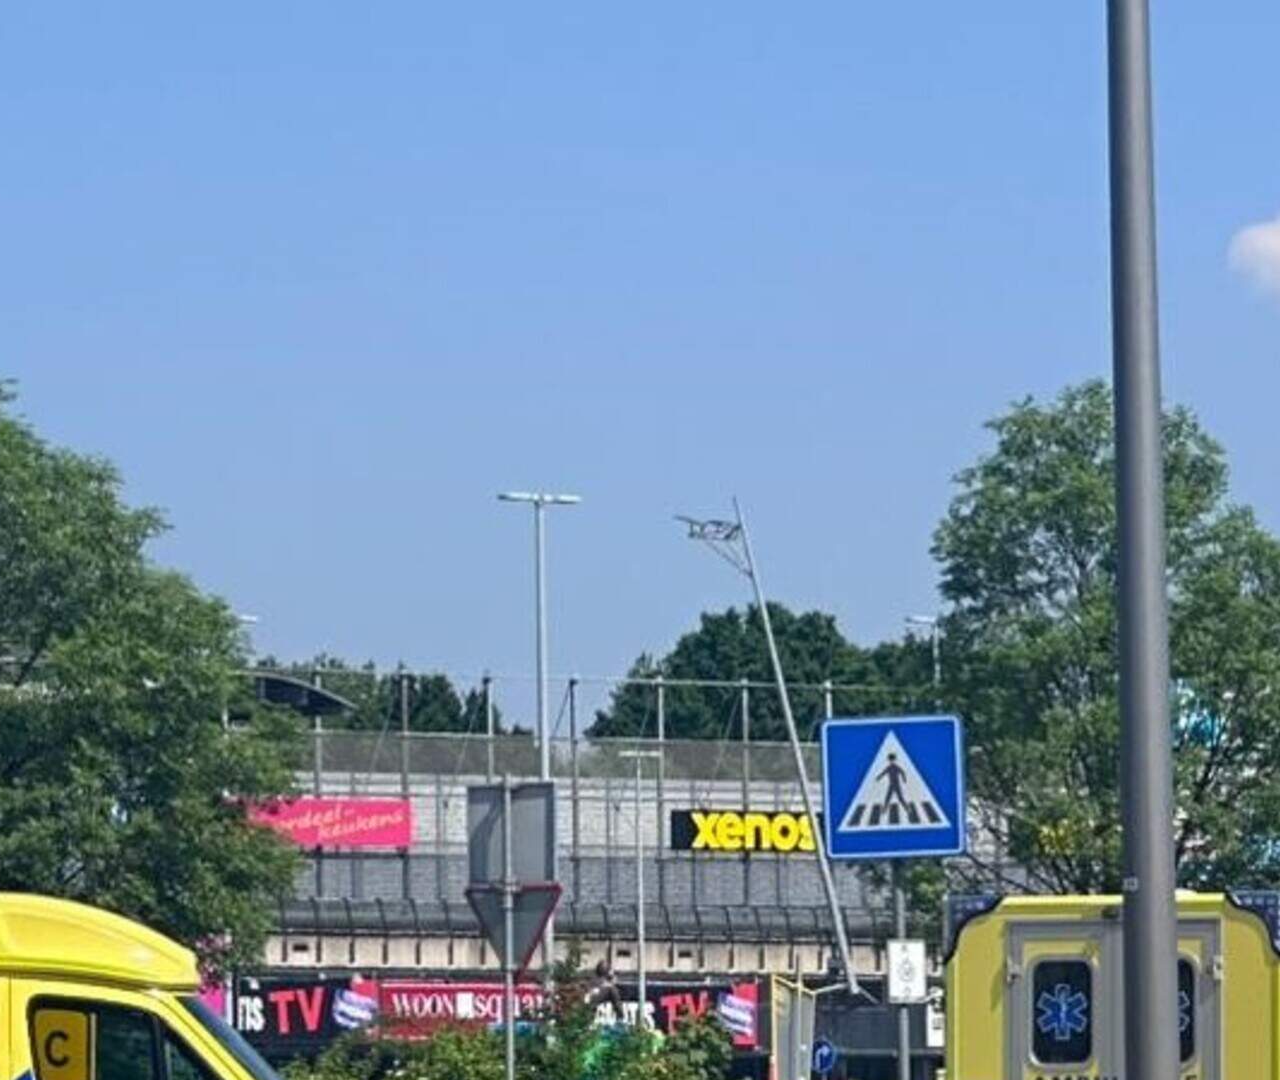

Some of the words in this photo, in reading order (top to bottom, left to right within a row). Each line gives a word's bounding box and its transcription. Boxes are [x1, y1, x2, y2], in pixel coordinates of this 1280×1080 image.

[691, 812, 815, 851] xenos
[268, 986, 325, 1034] TV
[44, 1030, 70, 1067] C
